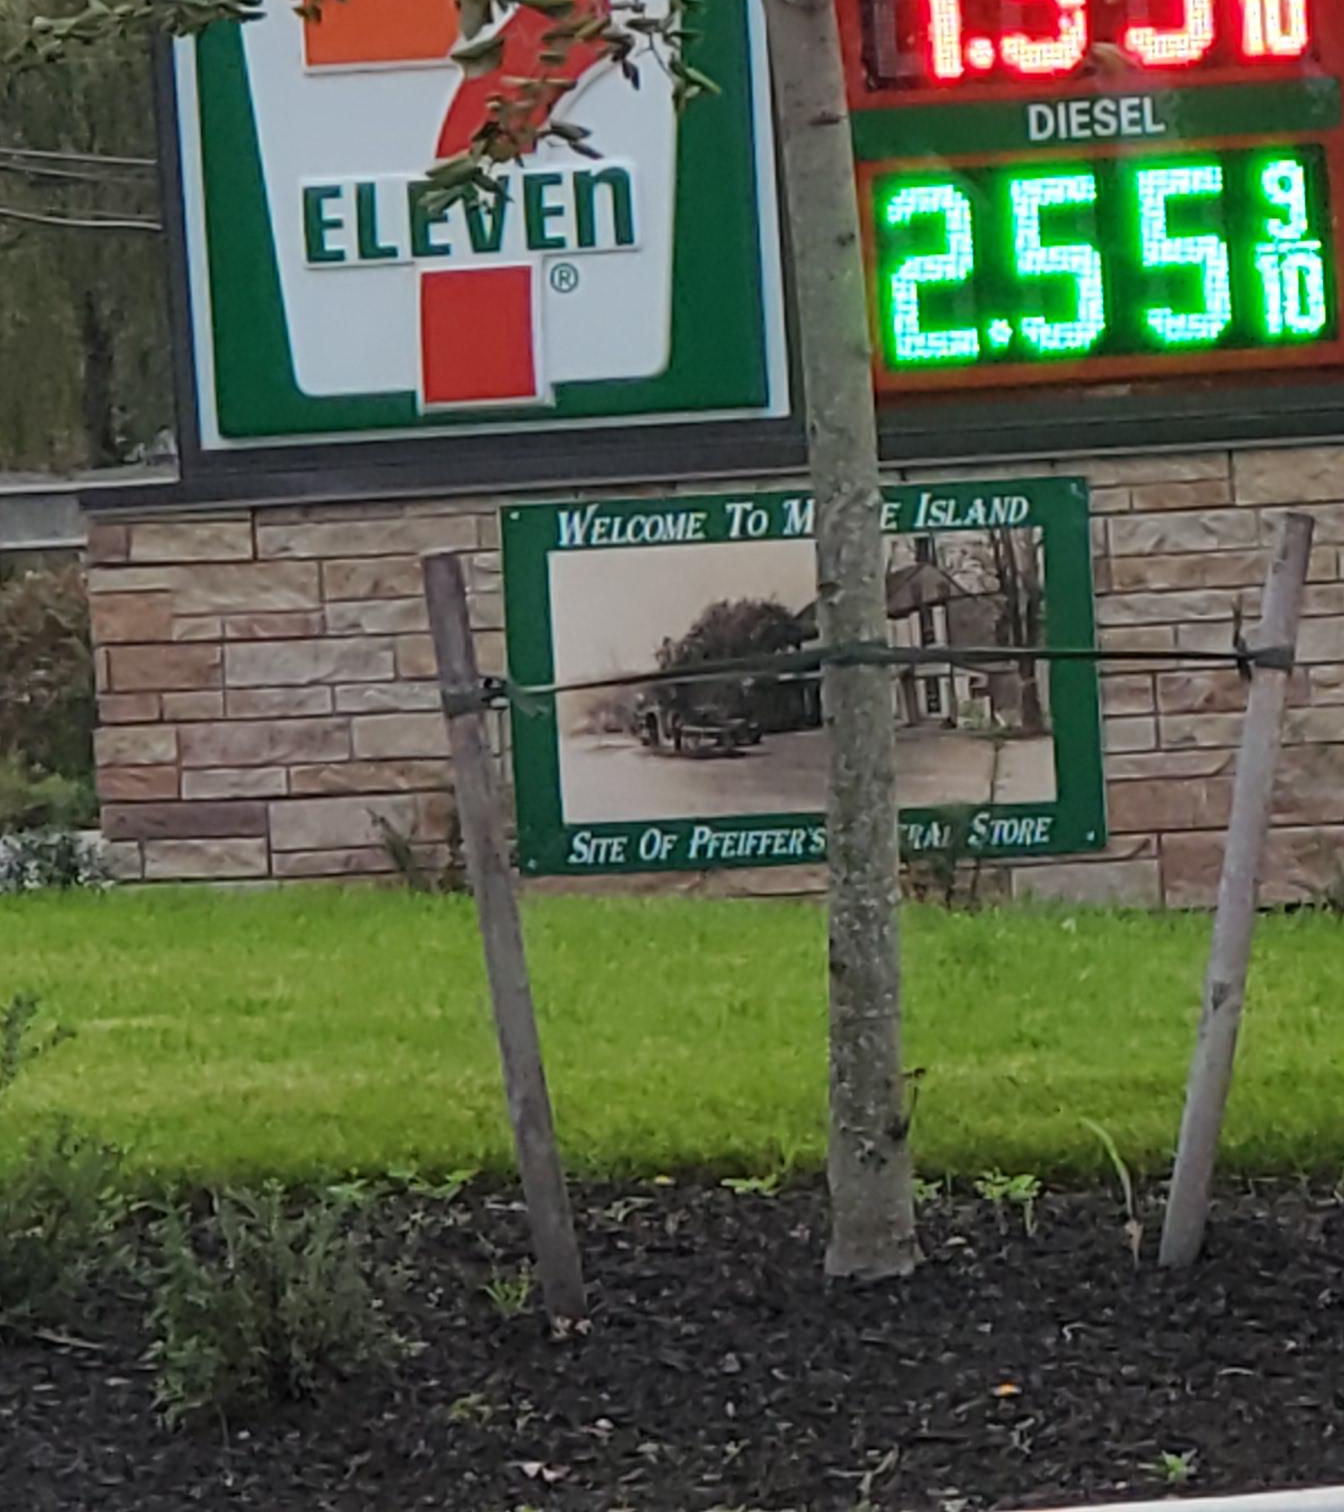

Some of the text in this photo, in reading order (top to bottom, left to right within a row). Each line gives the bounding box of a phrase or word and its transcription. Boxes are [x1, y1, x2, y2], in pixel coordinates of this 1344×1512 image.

[1027, 97, 1166, 141] DIESEL
[887, 165, 1232, 362] 2.55
[914, 492, 1029, 527] ISLAND
[568, 830, 627, 864] SITE
[968, 811, 1054, 848] STORE
